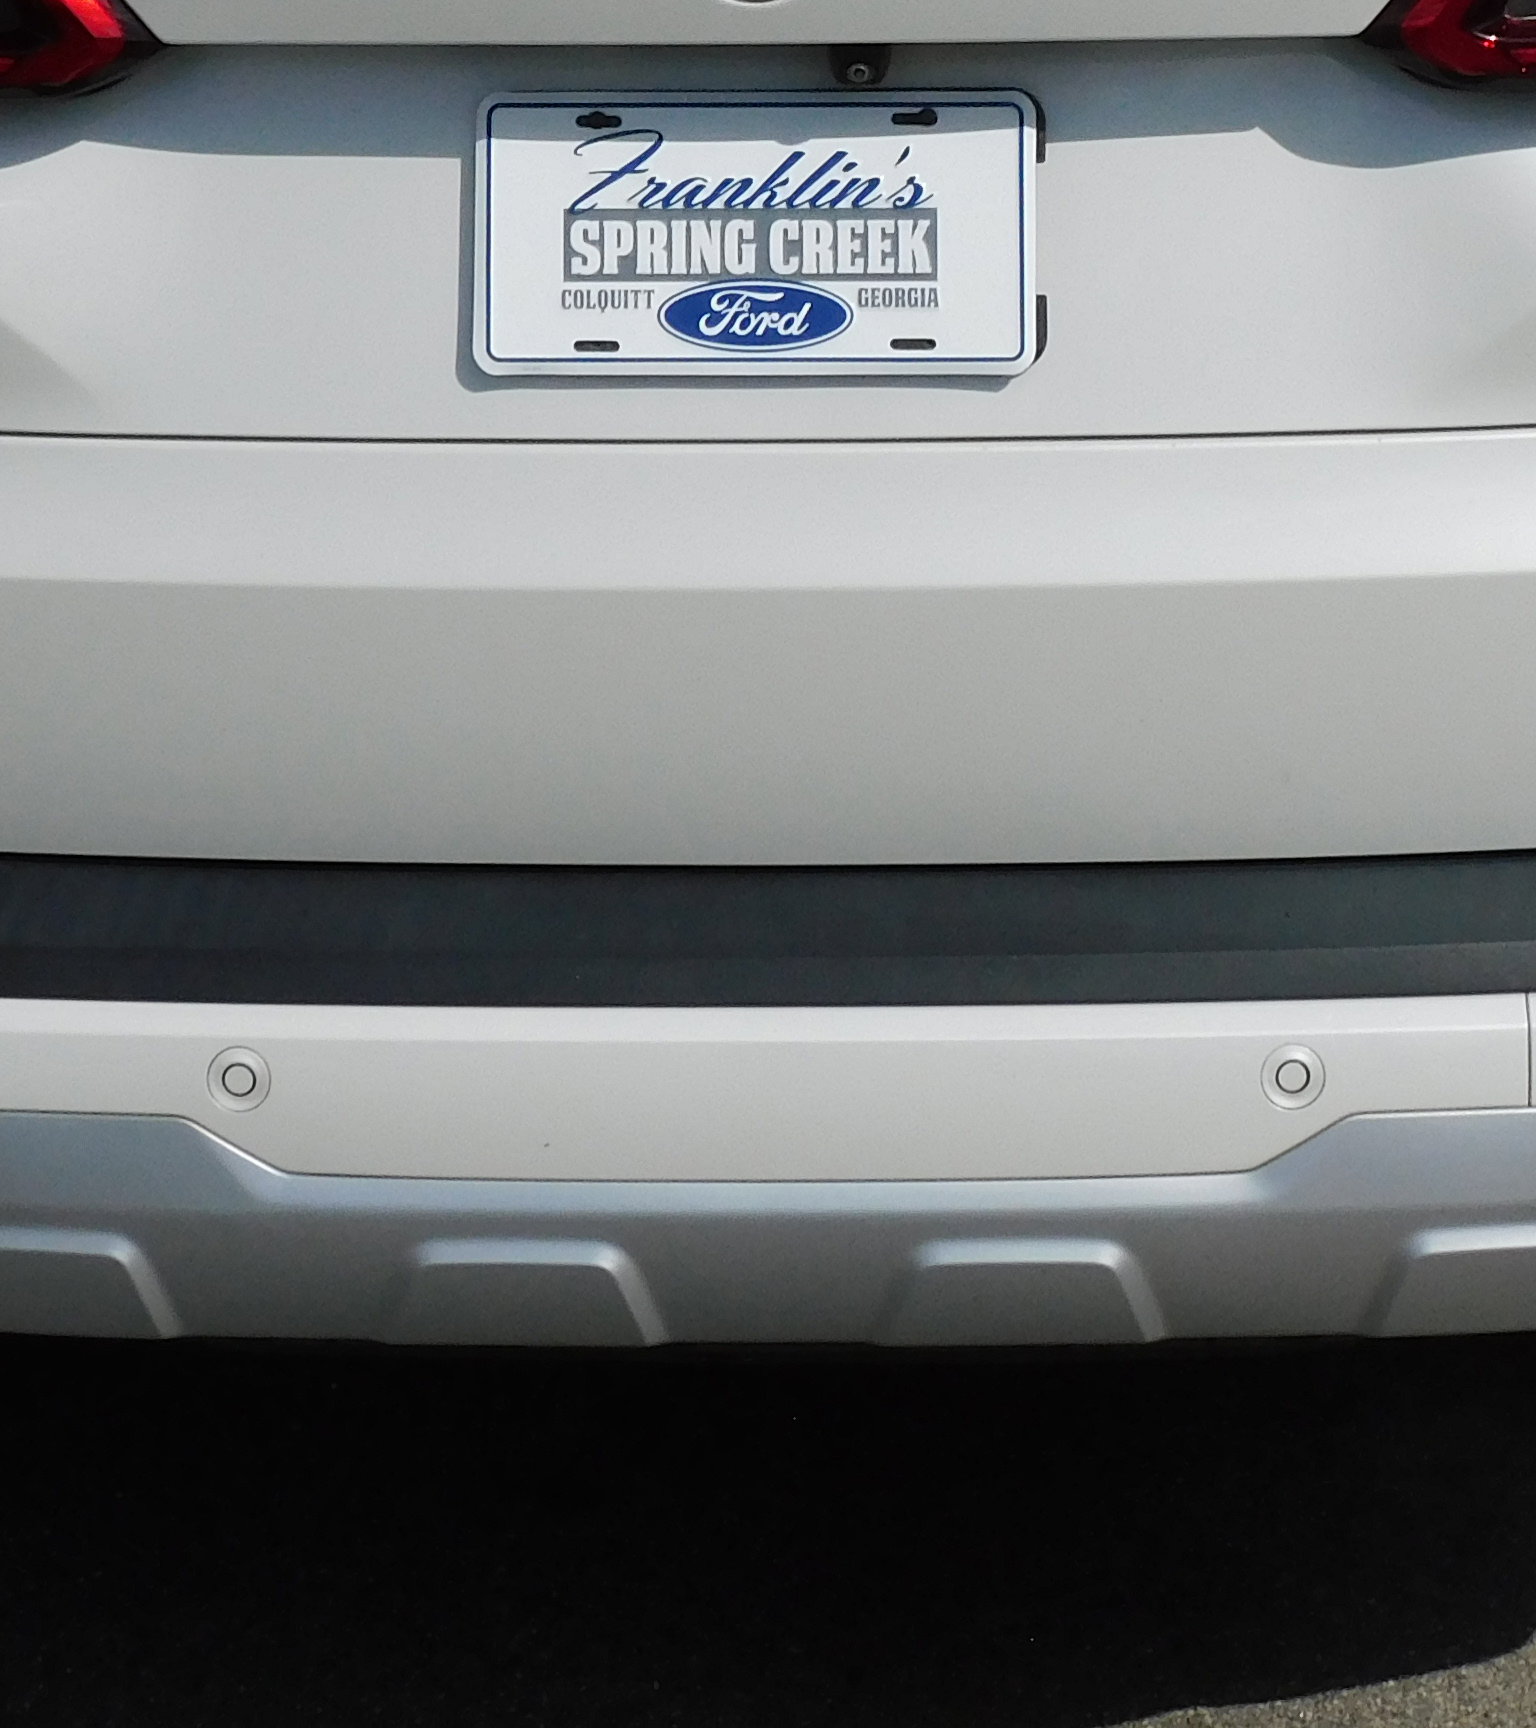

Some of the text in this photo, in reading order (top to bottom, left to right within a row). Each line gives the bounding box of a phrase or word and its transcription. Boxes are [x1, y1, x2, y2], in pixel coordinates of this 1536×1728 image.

[568, 129, 934, 215] Franklin's
[570, 219, 932, 276] SPRING CREEK
[561, 289, 655, 313] COLQUITT
[698, 289, 812, 336] Ford
[857, 287, 939, 309] GEORGIA
